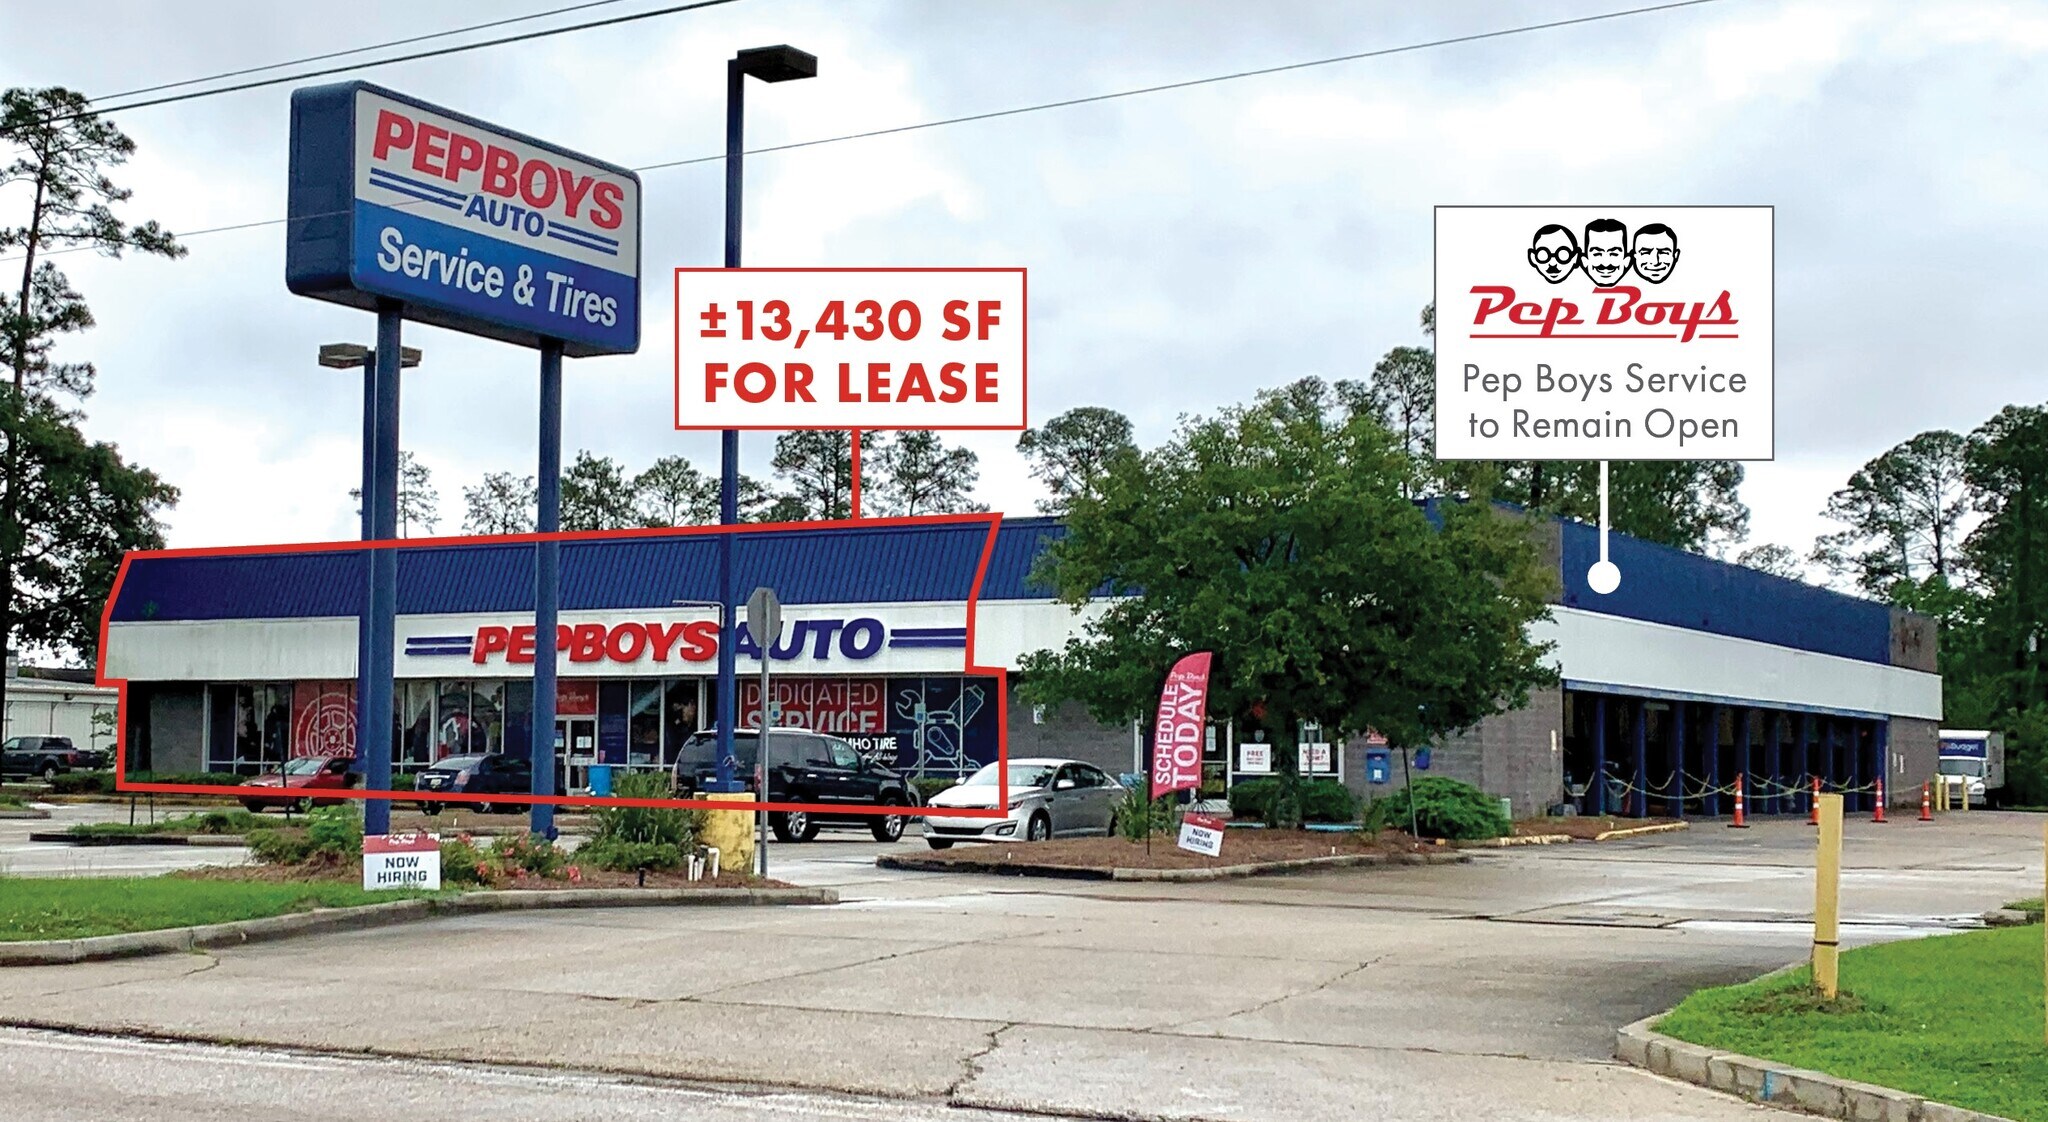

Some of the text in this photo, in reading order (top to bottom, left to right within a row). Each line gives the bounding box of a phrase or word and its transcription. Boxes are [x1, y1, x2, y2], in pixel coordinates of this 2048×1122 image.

[373, 109, 624, 229] PEPBOYS
[464, 195, 545, 237] AUTO
[377, 226, 618, 327] Service & Tires
[747, 710, 878, 732] SRVICE
[1155, 684, 1179, 785] SCHEDULE
[1172, 682, 1202, 788] TODAY
[872, 737, 898, 750] TIRE
[377, 870, 427, 883] HIRING
[385, 856, 420, 868] NOW
